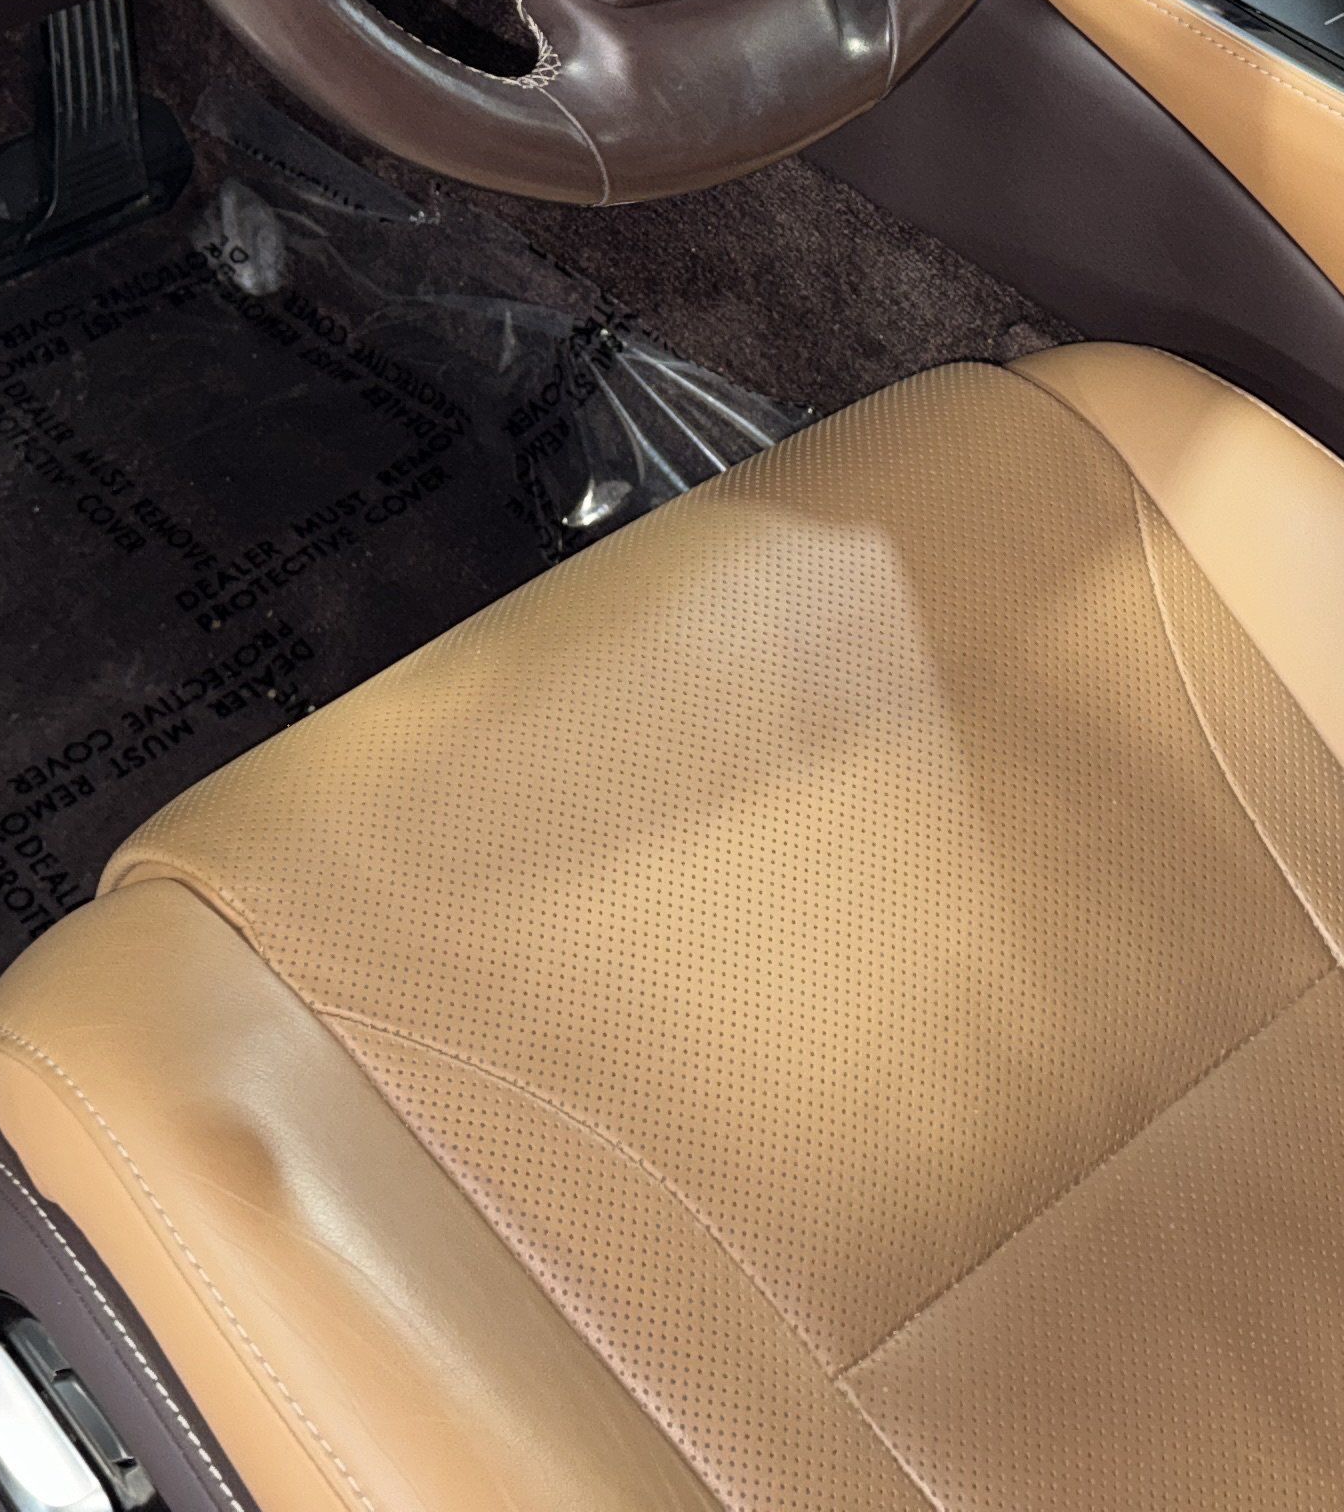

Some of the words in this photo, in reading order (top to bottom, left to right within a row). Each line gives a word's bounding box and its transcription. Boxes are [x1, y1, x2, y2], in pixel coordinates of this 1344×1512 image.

[77, 494, 146, 553] COVER
[176, 540, 280, 612] DEALER
[291, 490, 367, 537] MUST
[195, 526, 357, 632] PROTECTIVE
[365, 466, 451, 524] COVER
[122, 620, 293, 734] PROTECTIVE
[208, 639, 315, 718] DEALER
[8, 729, 113, 795] COVER
[109, 720, 194, 779] MUST
